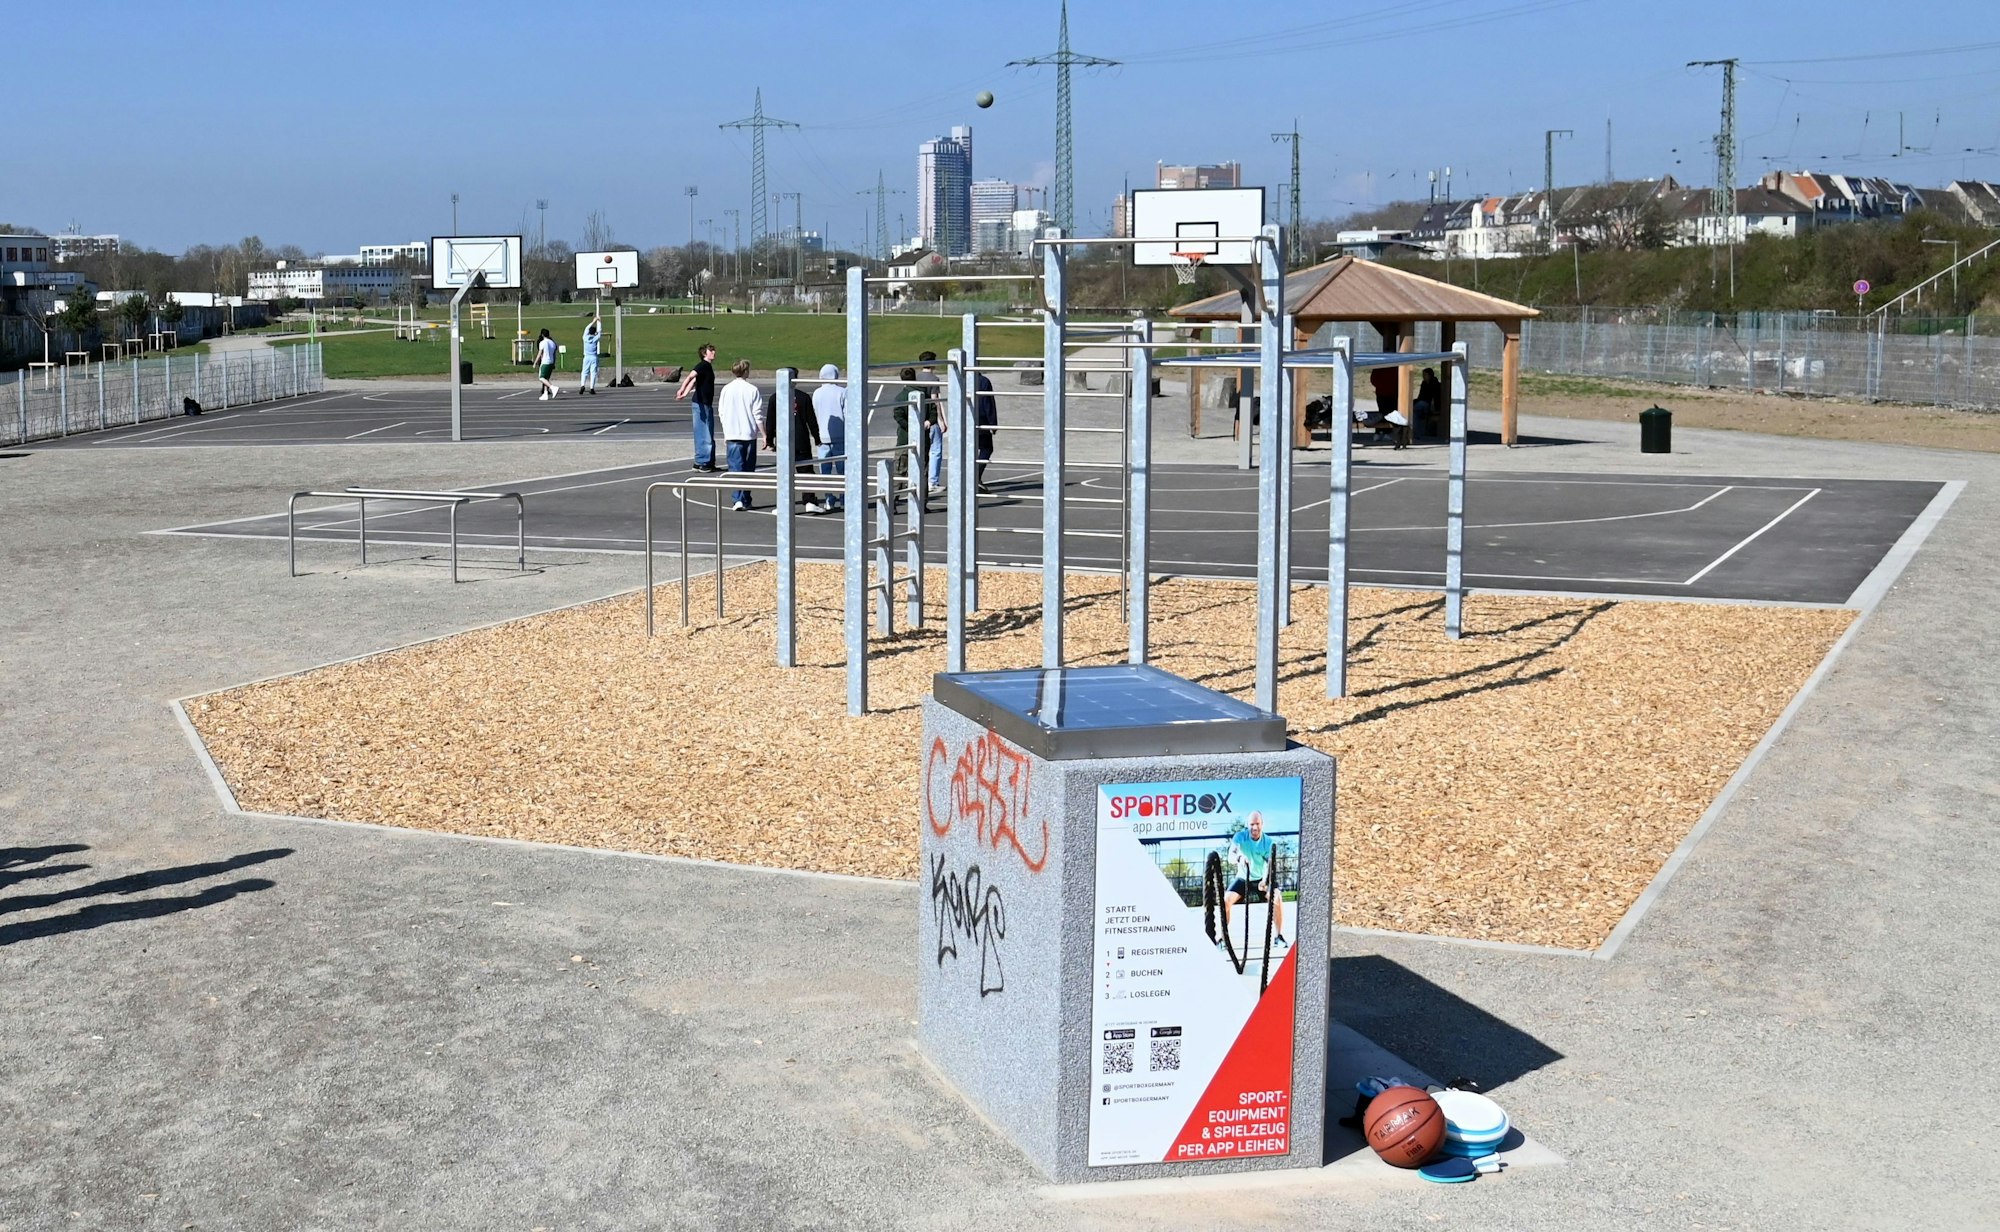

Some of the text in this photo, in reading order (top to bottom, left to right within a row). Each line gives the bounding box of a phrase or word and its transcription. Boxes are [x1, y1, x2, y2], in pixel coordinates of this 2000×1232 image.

[1110, 792, 1232, 818] SPORTBOX
[1133, 820, 1208, 834] app and move
[1105, 905, 1136, 913] STARTE
[1105, 915, 1150, 924] JETZT DEIN
[1104, 925, 1176, 934] FITNESSTRAINING
[1131, 947, 1188, 956] REGISTRIEREN
[1130, 969, 1163, 977] BUCHEN
[1130, 989, 1171, 998] LOSLEGEN
[1239, 1091, 1287, 1104] SPORT-
[1208, 1106, 1286, 1123] EQUIPMENT
[1201, 1122, 1285, 1139] & SPIELZEUG
[1373, 1107, 1420, 1141] TARMAK
[1178, 1138, 1285, 1156] PER APP LEIHEN
